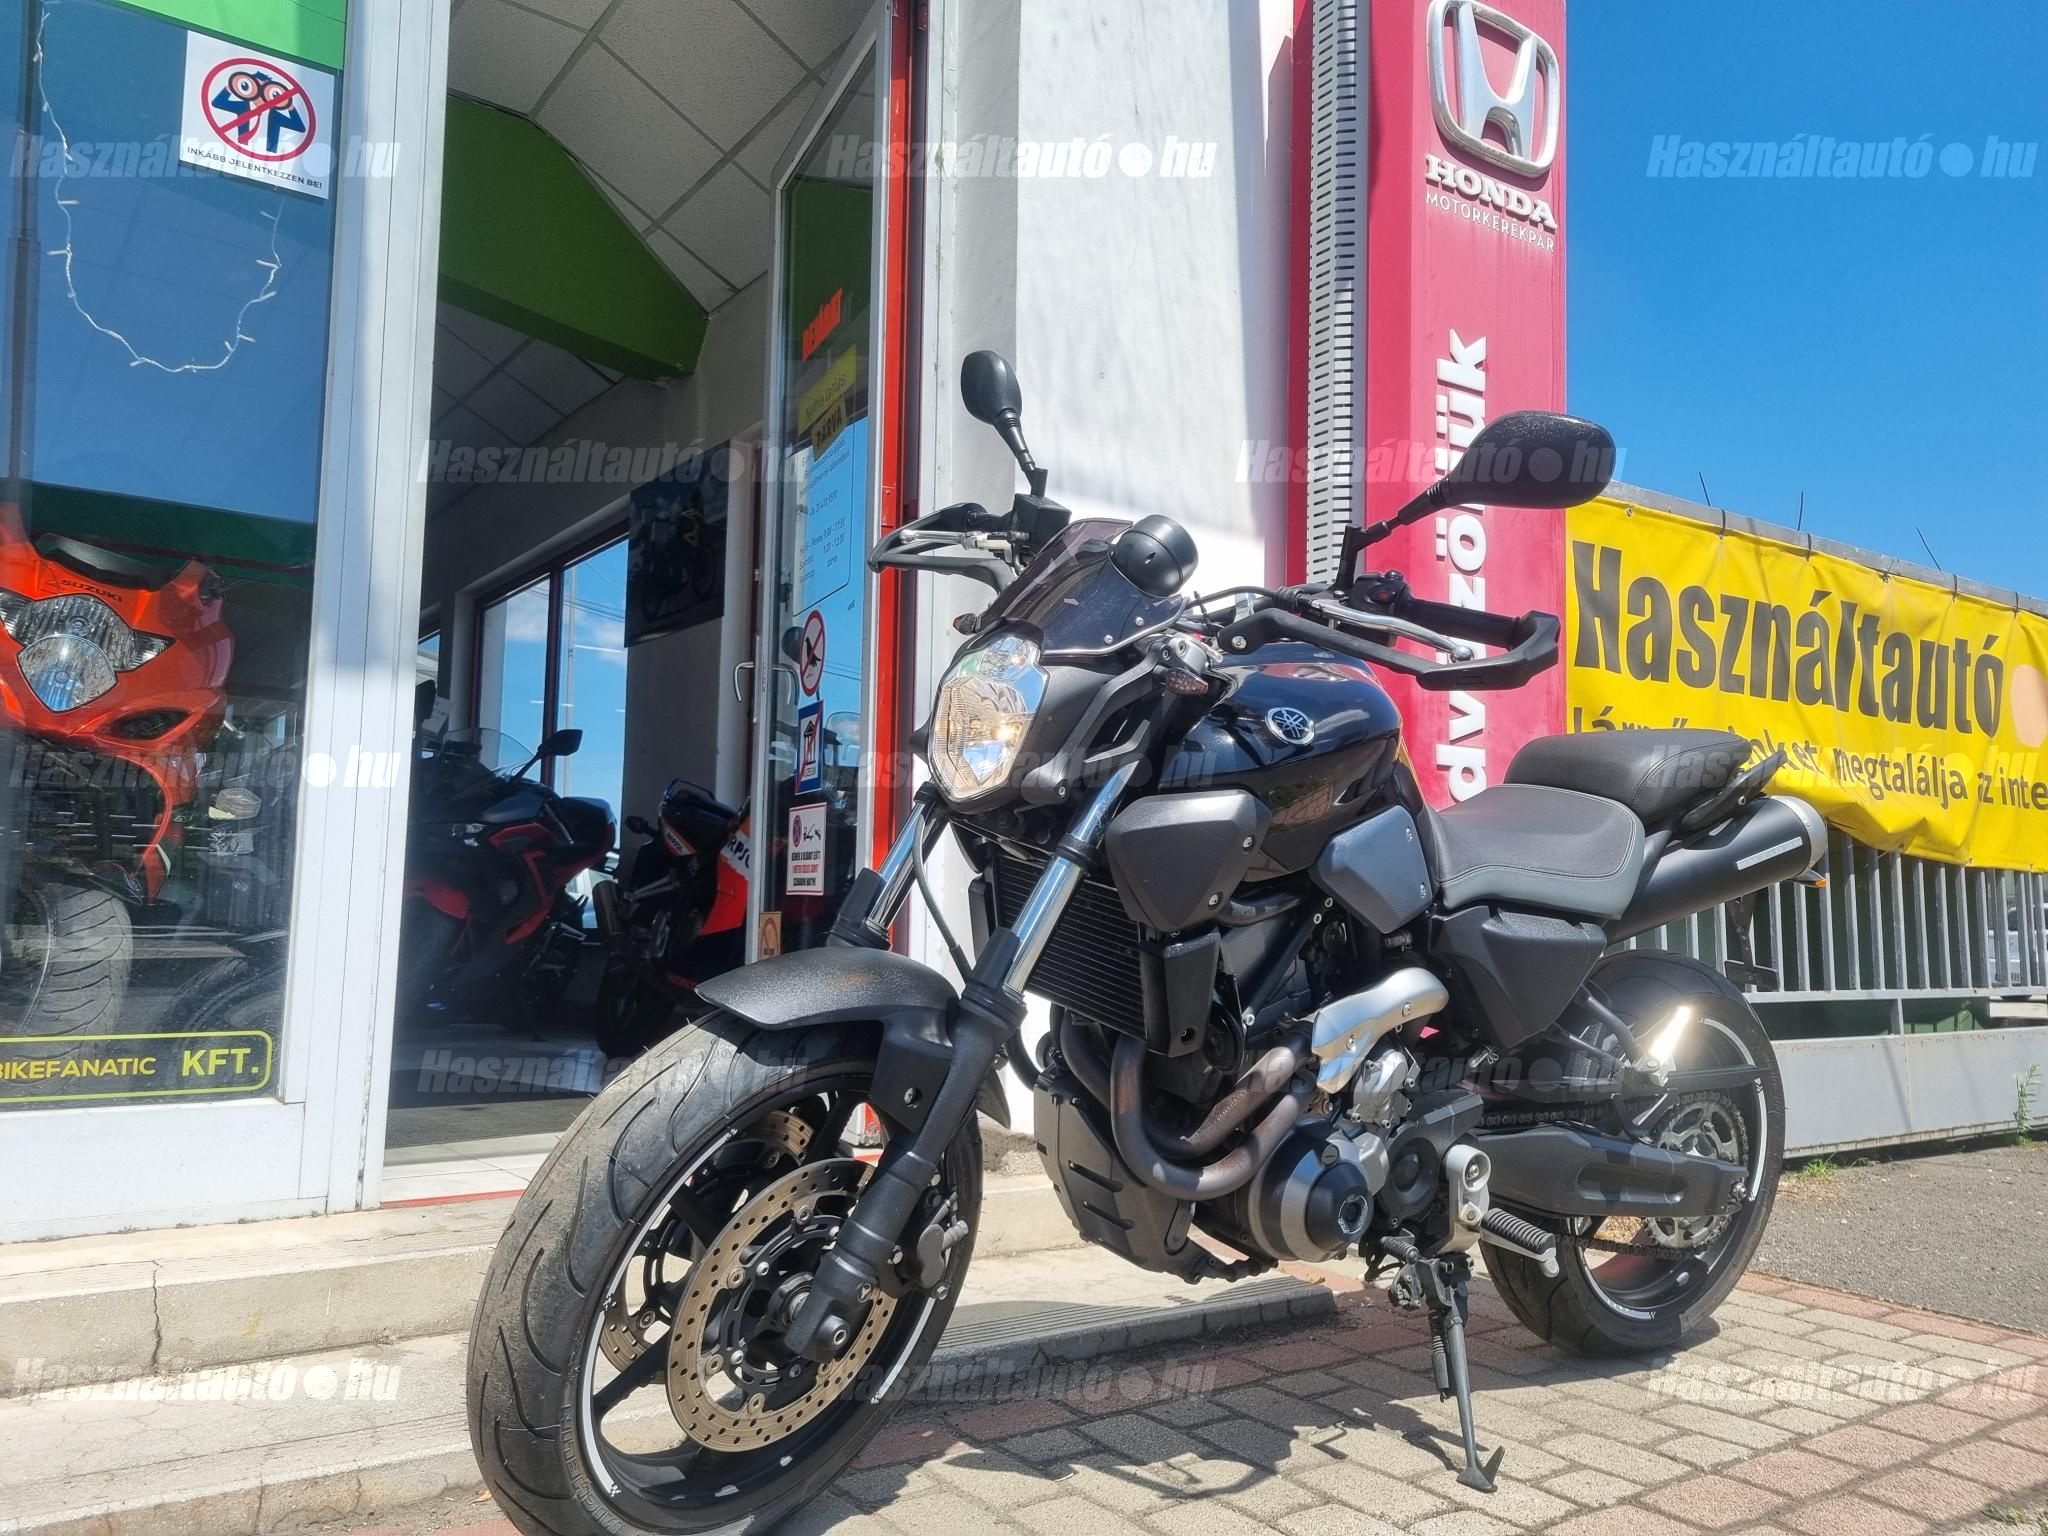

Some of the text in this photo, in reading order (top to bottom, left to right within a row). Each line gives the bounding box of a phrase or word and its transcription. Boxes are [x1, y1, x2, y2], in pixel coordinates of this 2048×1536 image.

[228, 158, 305, 185] JELENTKEZZEN
[306, 178, 323, 190] BE!
[1425, 153, 1558, 230] HONDA
[1425, 189, 1555, 254] MOTORKERÉKPÁR
[61, 579, 123, 602] SUZUKI
[1572, 540, 2005, 739] Használtautó
[1832, 747, 1969, 810] megtalálja
[181, 1047, 260, 1077] KFT.
